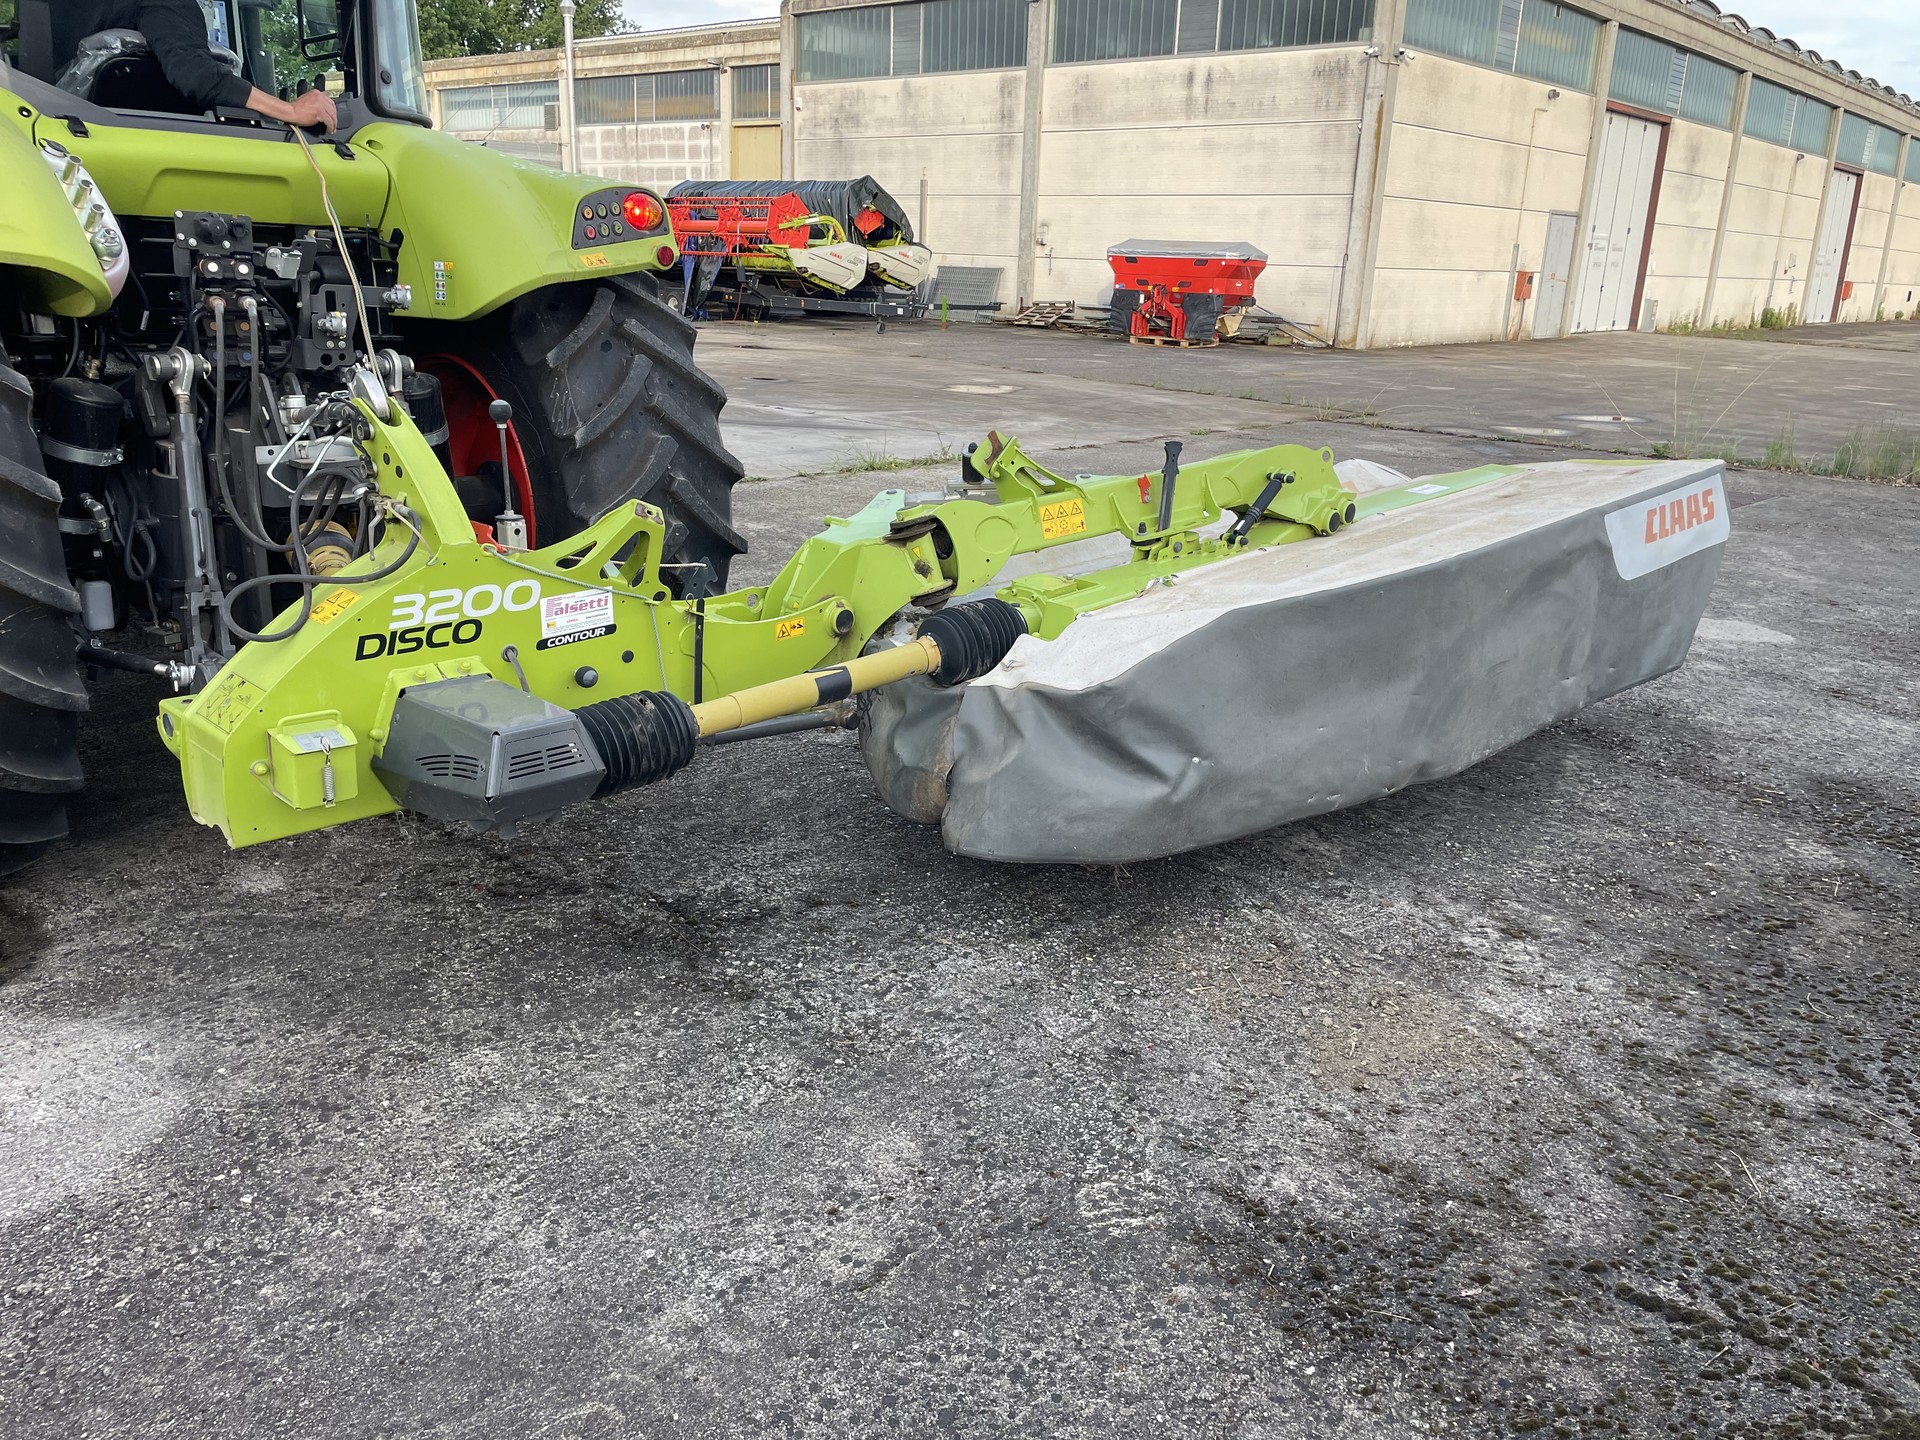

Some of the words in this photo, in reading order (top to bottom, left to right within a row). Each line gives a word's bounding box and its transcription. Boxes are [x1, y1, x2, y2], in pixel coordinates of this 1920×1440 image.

[1644, 487, 1715, 545] CLAAS
[388, 579, 542, 630] 3200
[545, 595, 609, 618] Falsetti
[355, 618, 483, 661] DISCO
[546, 627, 606, 648] CONTOUR
